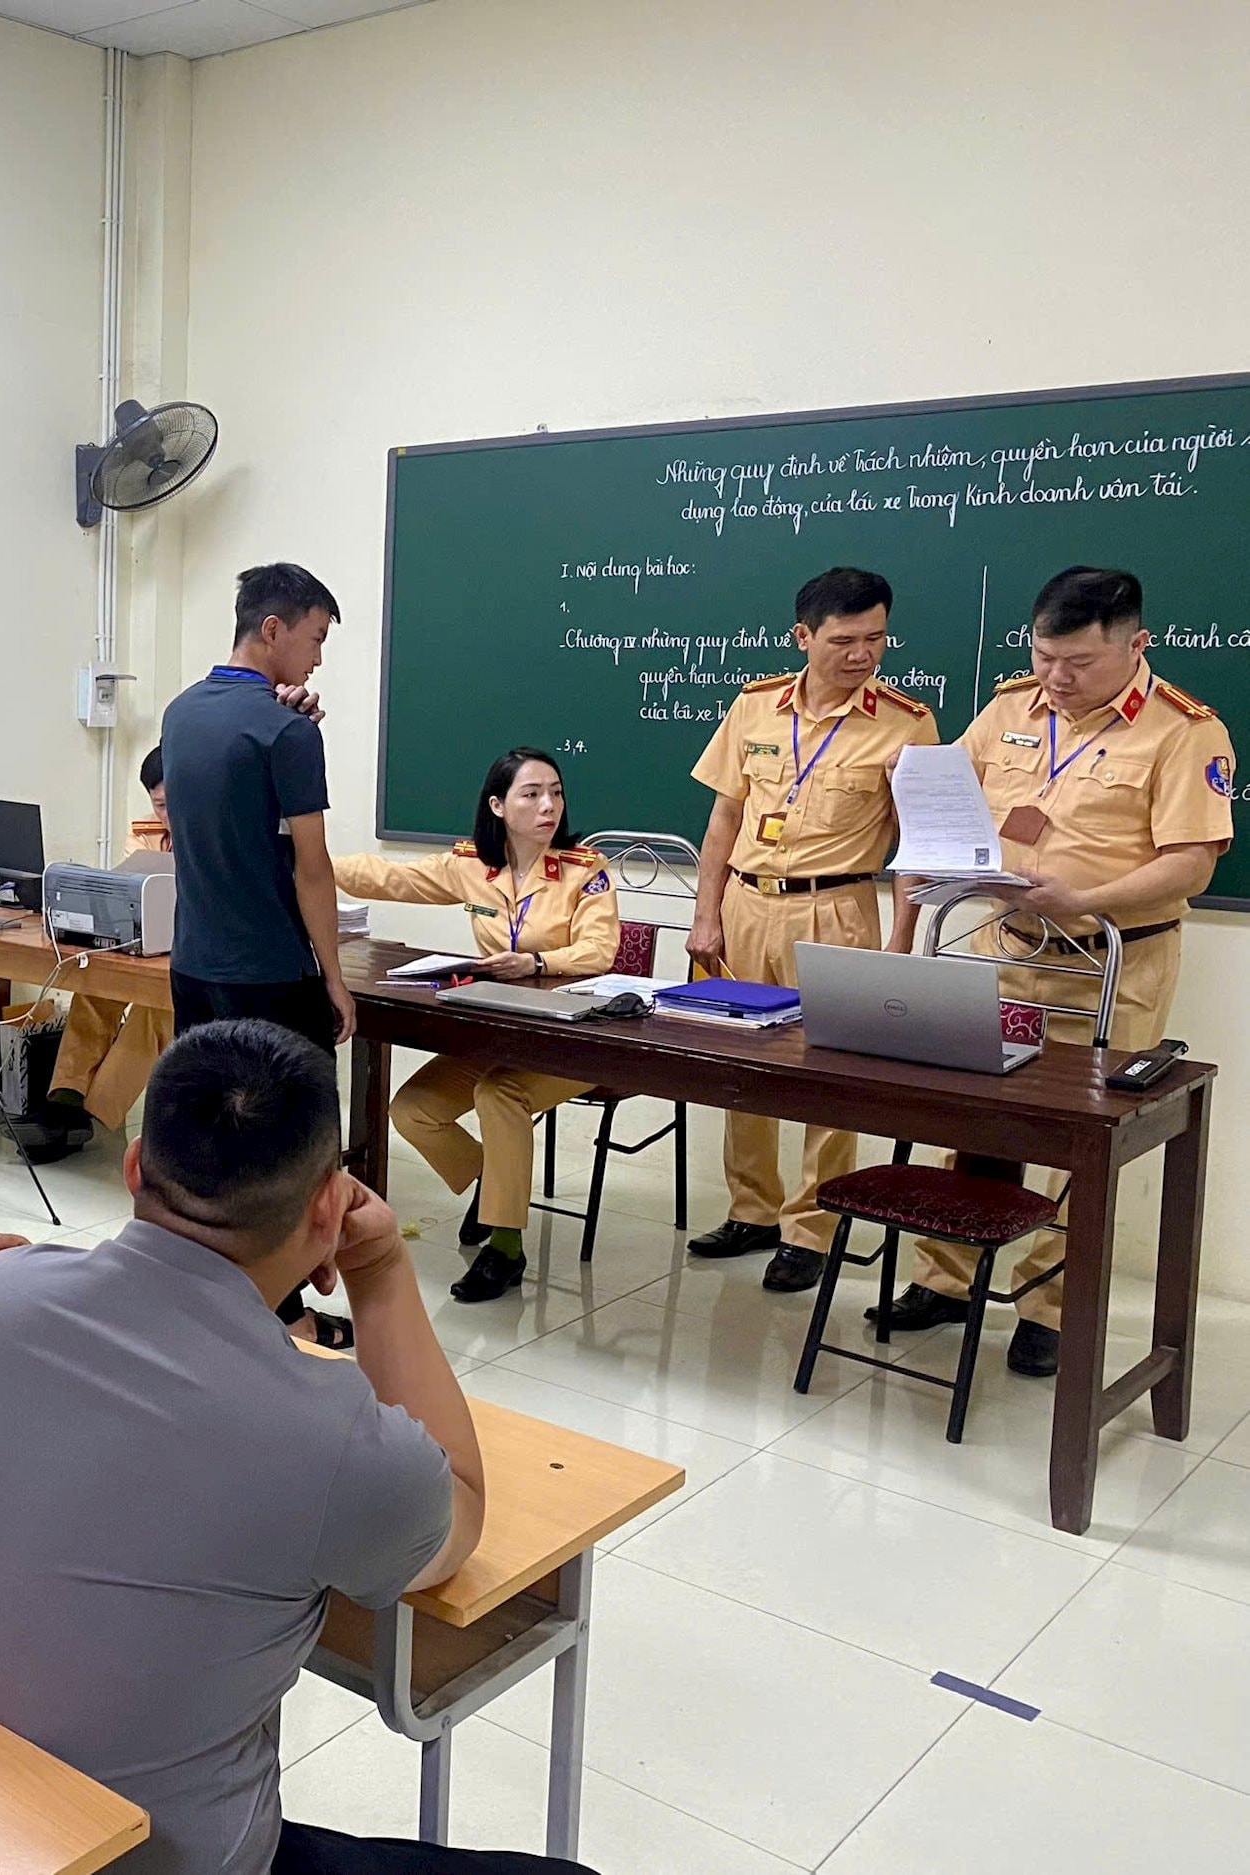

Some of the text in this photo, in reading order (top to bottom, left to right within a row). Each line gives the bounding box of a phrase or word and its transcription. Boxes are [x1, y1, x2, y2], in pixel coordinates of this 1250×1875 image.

[730, 463, 775, 499] quy
[780, 453, 826, 478] định
[828, 452, 851, 474] về
[991, 438, 1066, 483] quyền
[1068, 432, 1124, 463] hạn
[681, 498, 726, 537] dụng
[730, 497, 758, 517] lao
[846, 489, 877, 511] lái
[883, 496, 902, 510] xe
[1020, 476, 1095, 504] doanh
[1100, 478, 1149, 502] vận
[602, 556, 642, 595] dung
[646, 556, 664, 576] bài
[695, 635, 728, 666] quy
[773, 628, 794, 648] về
[1164, 623, 1223, 649] hành
[639, 666, 686, 701] quyền
[689, 663, 722, 689] hạn
[902, 667, 947, 709] động
[695, 708, 714, 721] xe
